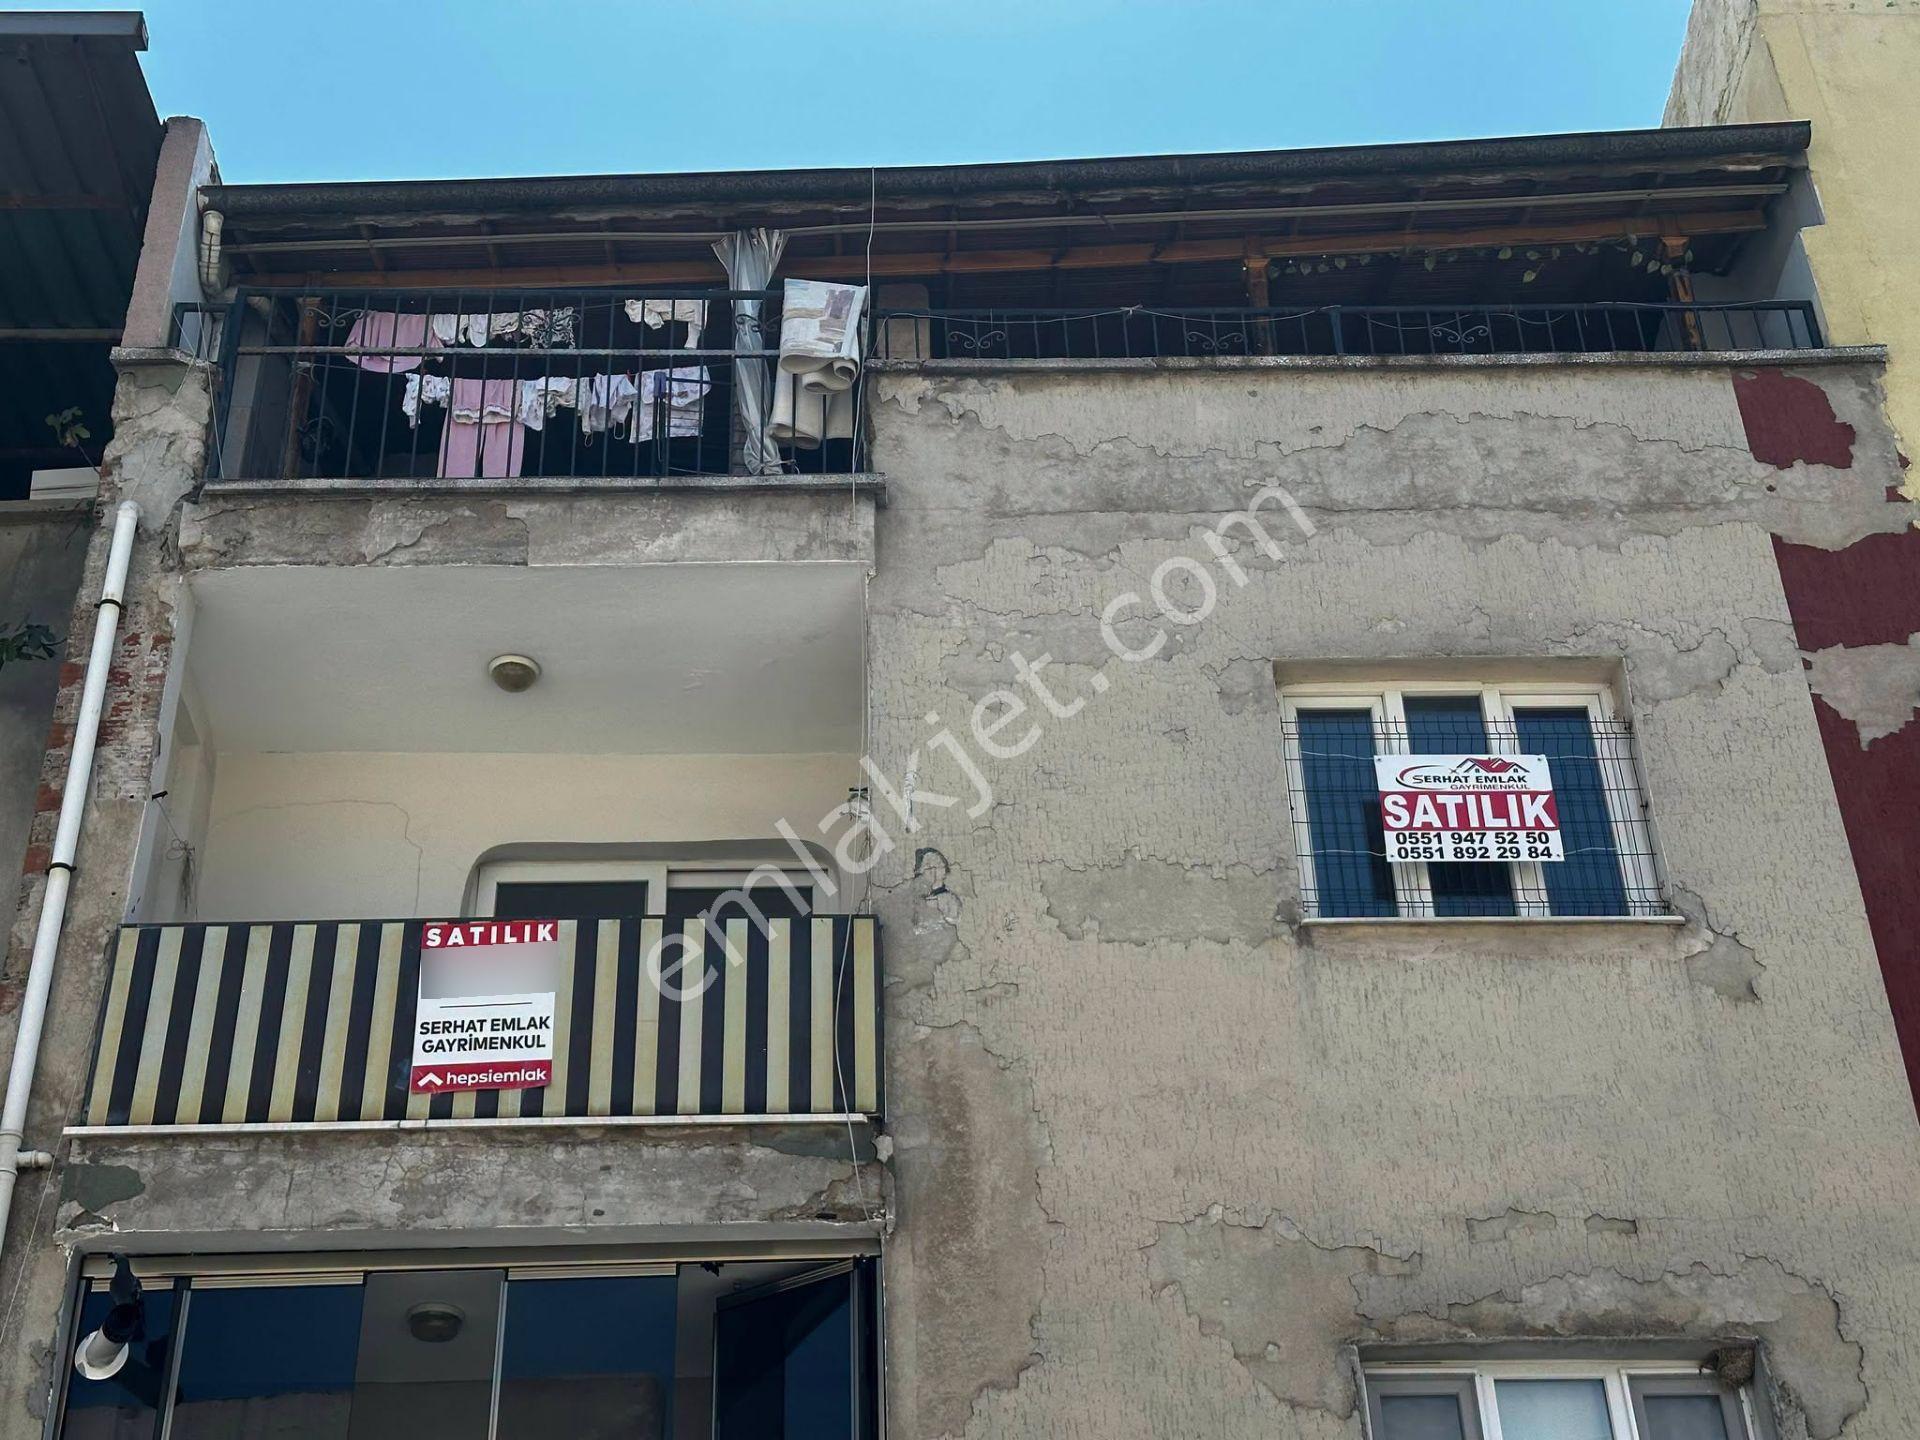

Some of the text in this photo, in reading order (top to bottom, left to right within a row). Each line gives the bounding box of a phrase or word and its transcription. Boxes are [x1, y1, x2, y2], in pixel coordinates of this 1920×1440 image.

[1412, 774, 1528, 784] SERHAT EMLAK
[1384, 794, 1556, 828] SATILIK
[1395, 832, 1550, 845] 0551 947 52 50
[1397, 846, 1553, 859] 0551 892 29 84
[426, 923, 553, 947] SATILIK
[419, 1016, 550, 1035] SERHAT EMLAK
[421, 1034, 546, 1053] GAYRİMENKUL
[446, 1069, 546, 1086] hepsiemlak
